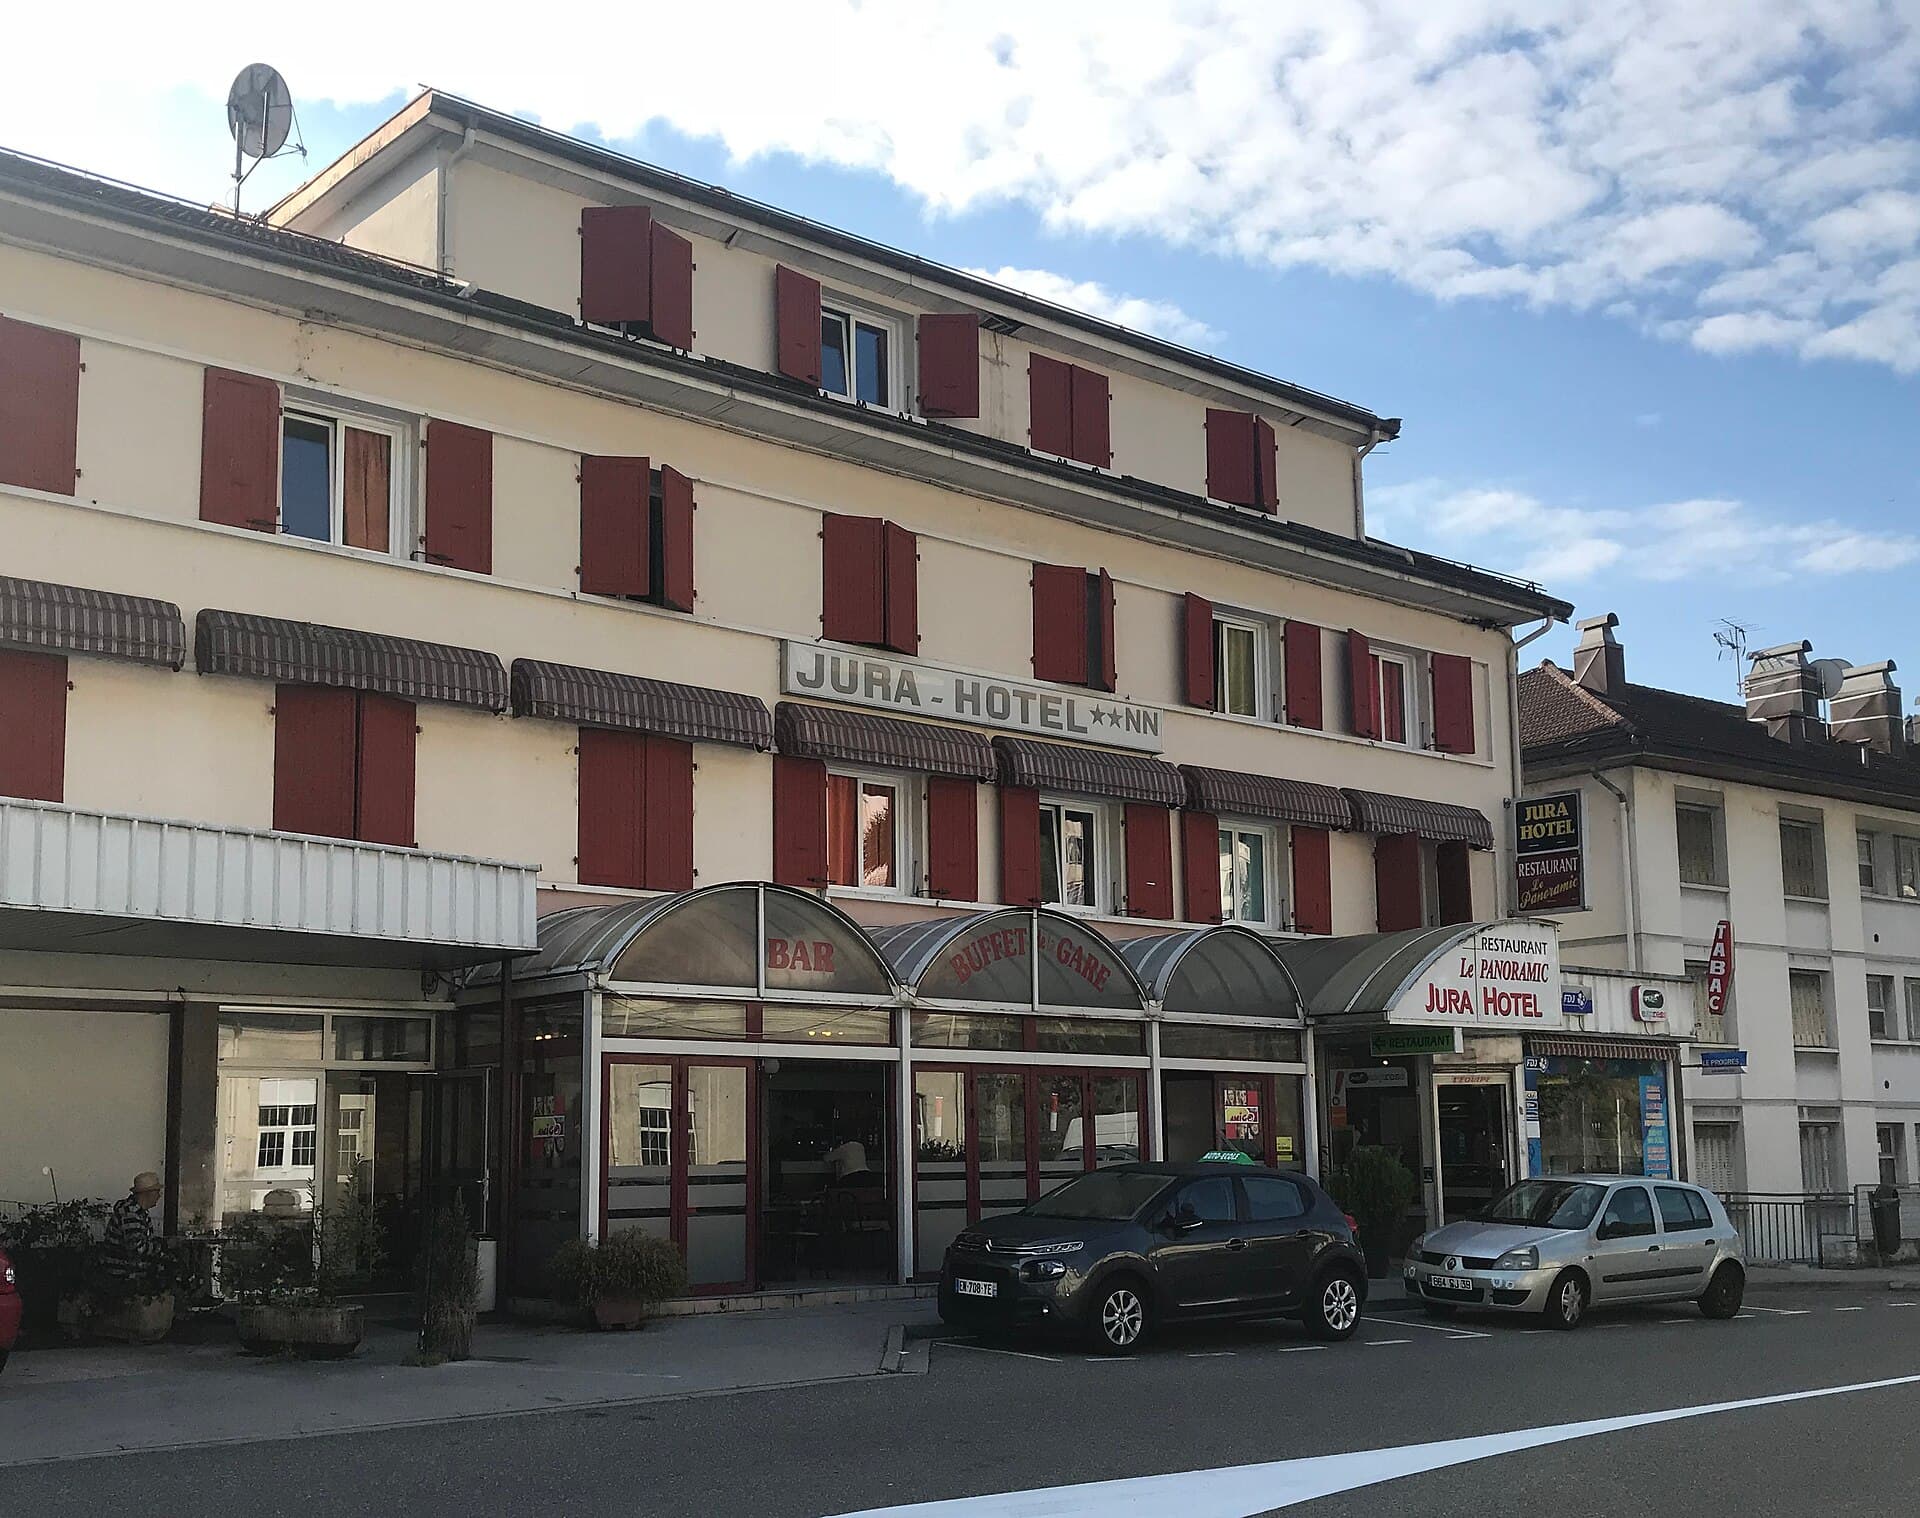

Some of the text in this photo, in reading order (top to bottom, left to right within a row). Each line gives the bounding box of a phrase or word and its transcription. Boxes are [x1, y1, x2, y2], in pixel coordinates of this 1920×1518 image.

[797, 654, 921, 707] JURA
[955, 679, 1088, 734] HOTEL
[1125, 708, 1159, 737] NN
[1525, 801, 1569, 821] JURA
[1520, 819, 1575, 840] HOTEL
[1518, 857, 1578, 877] RESTAURANT
[1520, 875, 1579, 909] Panoramic
[1532, 879, 1544, 891] Le
[768, 938, 836, 972] BAR
[1481, 937, 1548, 955] RESTAURANT
[950, 928, 1027, 984] BUFFET
[1056, 937, 1111, 993] GARE
[1460, 958, 1549, 983] Le PANORAMIC
[1709, 924, 1726, 1011] TABAC
[1425, 983, 1543, 1018] JURA HOTEL
[1563, 993, 1576, 1003] FDJ
[1389, 1035, 1450, 1048] RESTAURANT
[1526, 1059, 1538, 1067] FDJ
[1460, 1280, 1471, 1289] 39
